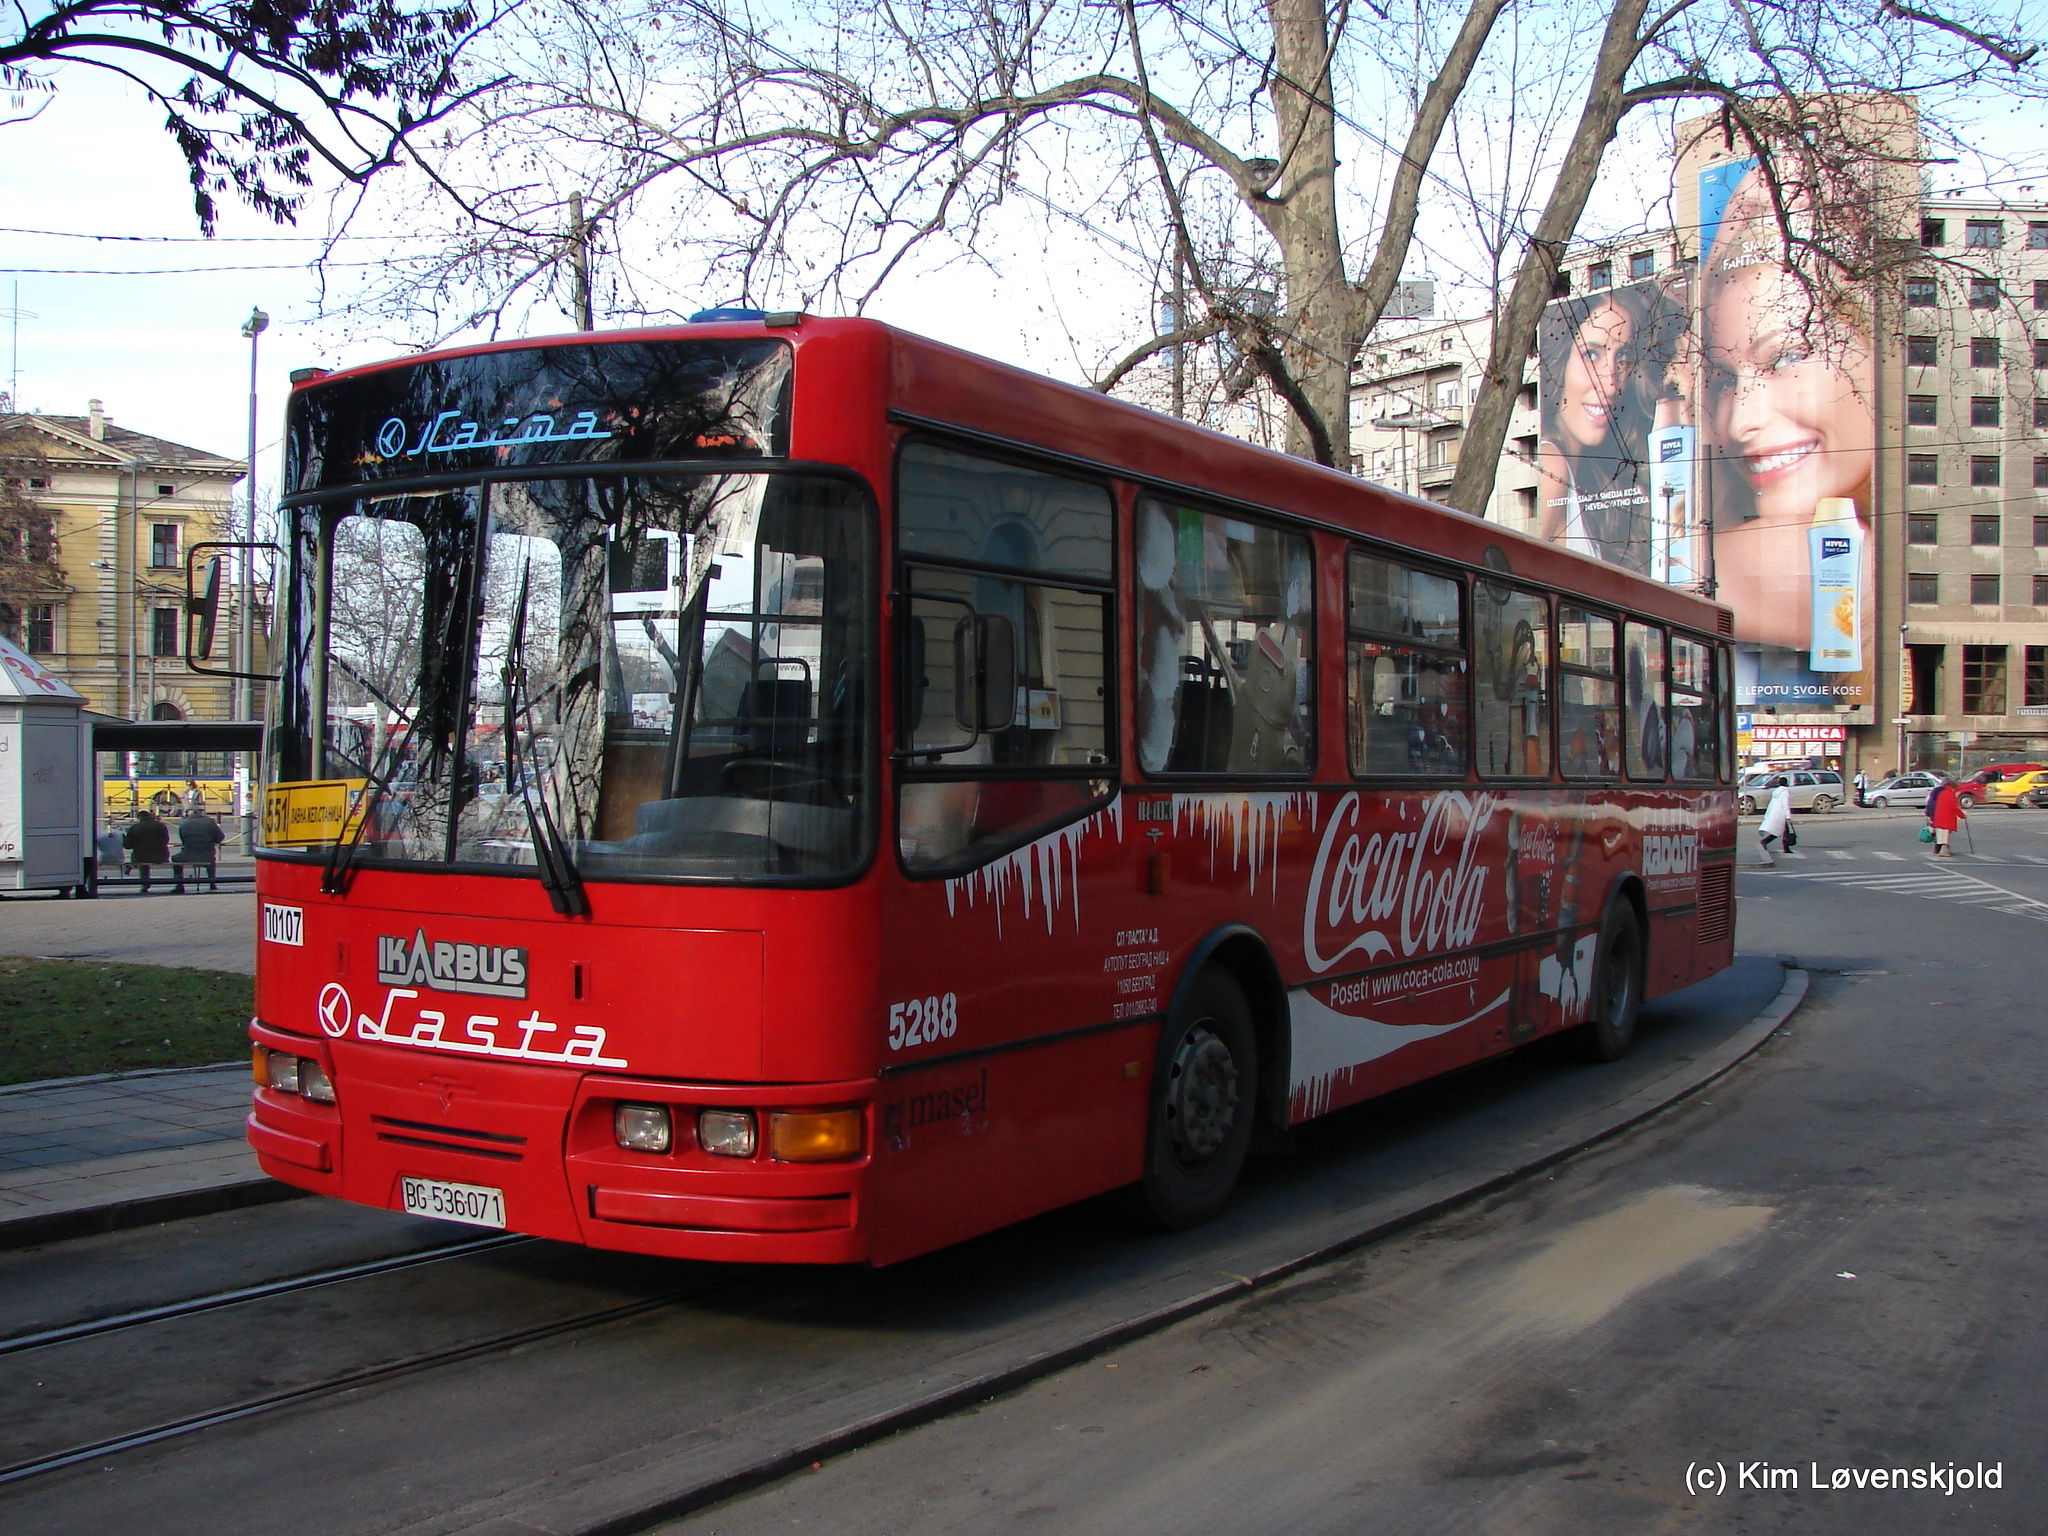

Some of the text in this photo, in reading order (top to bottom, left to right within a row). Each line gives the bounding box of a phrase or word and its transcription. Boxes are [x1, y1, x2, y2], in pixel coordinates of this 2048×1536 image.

[1662, 440, 1681, 450] NIVEA
[1824, 540, 1849, 548] NIVEA
[1745, 685, 1789, 696] LEPOTU
[1793, 685, 1829, 696] SVOJE
[1832, 685, 1862, 696] KOSE
[266, 797, 288, 833] 551
[1303, 790, 1498, 974] Coca-Cola
[378, 928, 526, 986] IKARBUS
[1330, 956, 1480, 1007] Poseti www.coca-cola.co.yu
[358, 988, 628, 1069] Lasta
[888, 992, 958, 1051] 5288
